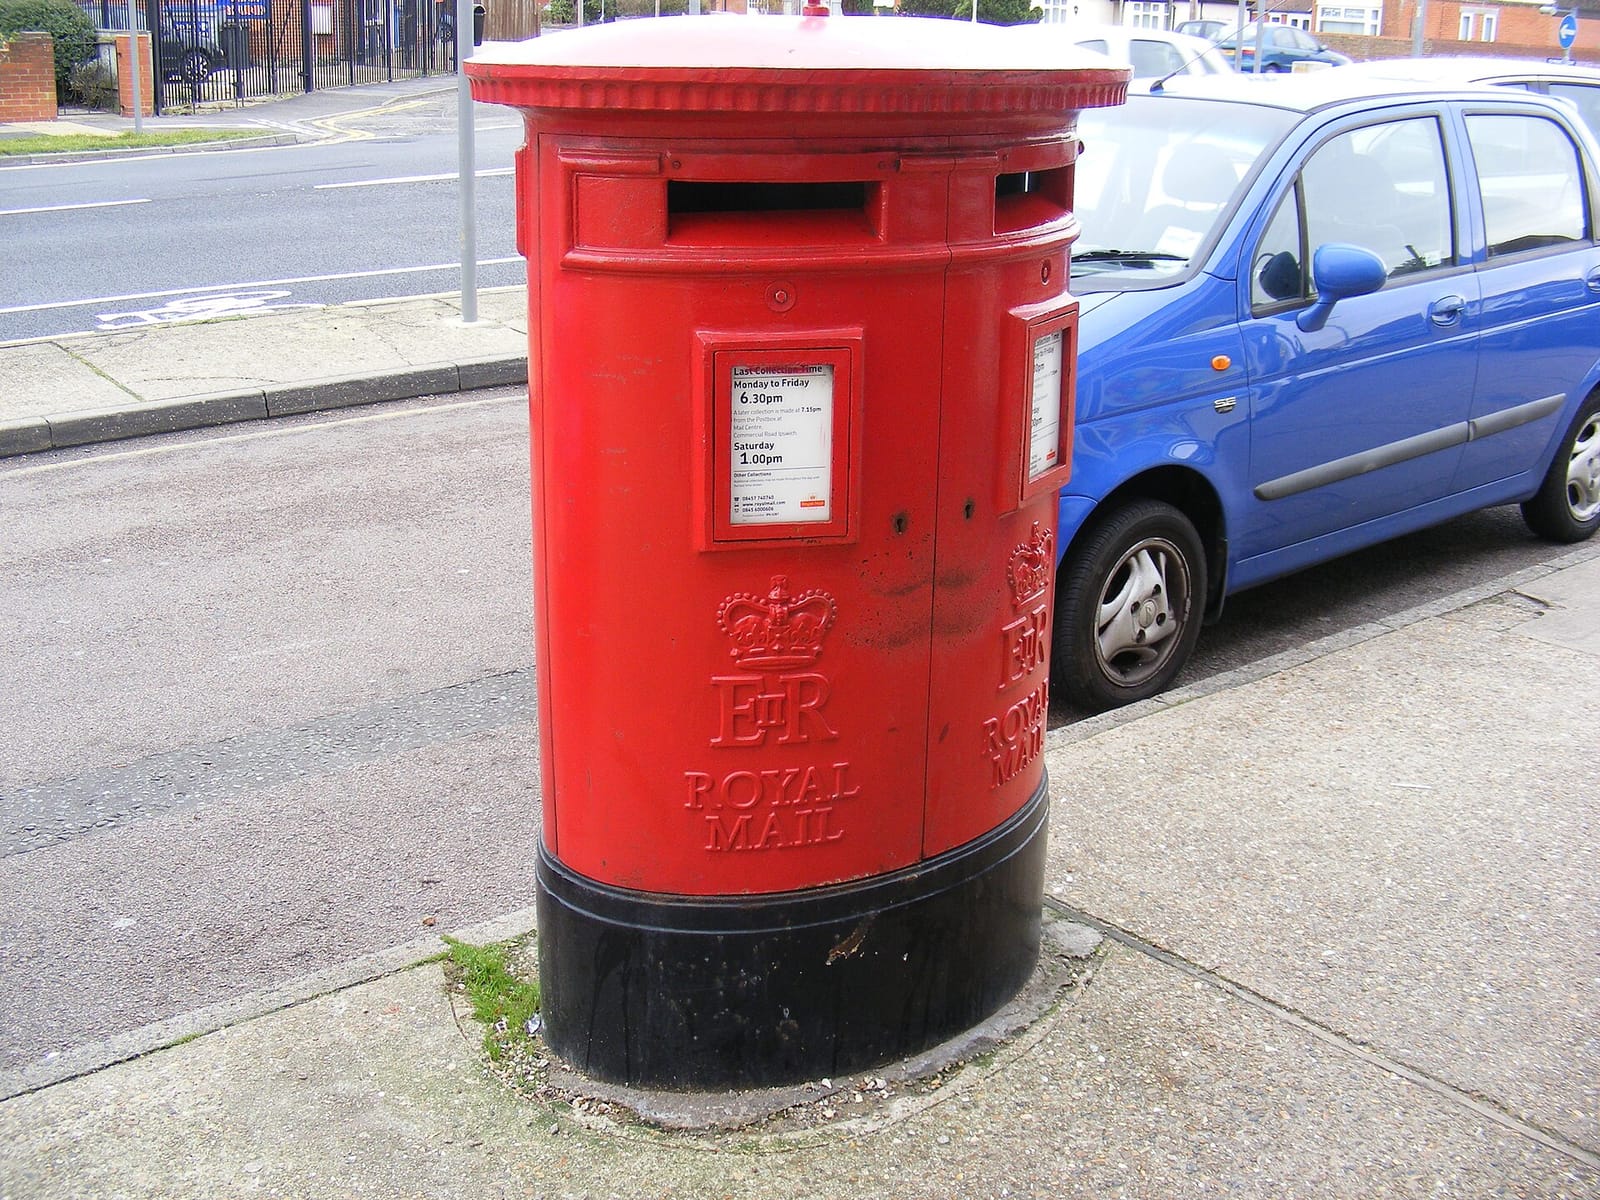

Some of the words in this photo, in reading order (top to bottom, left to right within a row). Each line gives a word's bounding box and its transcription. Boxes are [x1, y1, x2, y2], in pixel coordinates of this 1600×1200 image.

[734, 367, 753, 376] Last
[755, 365, 799, 375] Collection
[800, 364, 823, 374] Time
[734, 380, 769, 390] Monday
[770, 379, 780, 388] to
[781, 378, 810, 389] Friday
[740, 391, 783, 405] 6.30pm
[734, 442, 775, 452] Saturday
[740, 452, 783, 465] 1.00pm
[983, 677, 1049, 754] ROYAL
[991, 720, 1045, 789] MAIL
[684, 762, 860, 810] ROYAL
[704, 806, 845, 851] MAIL
